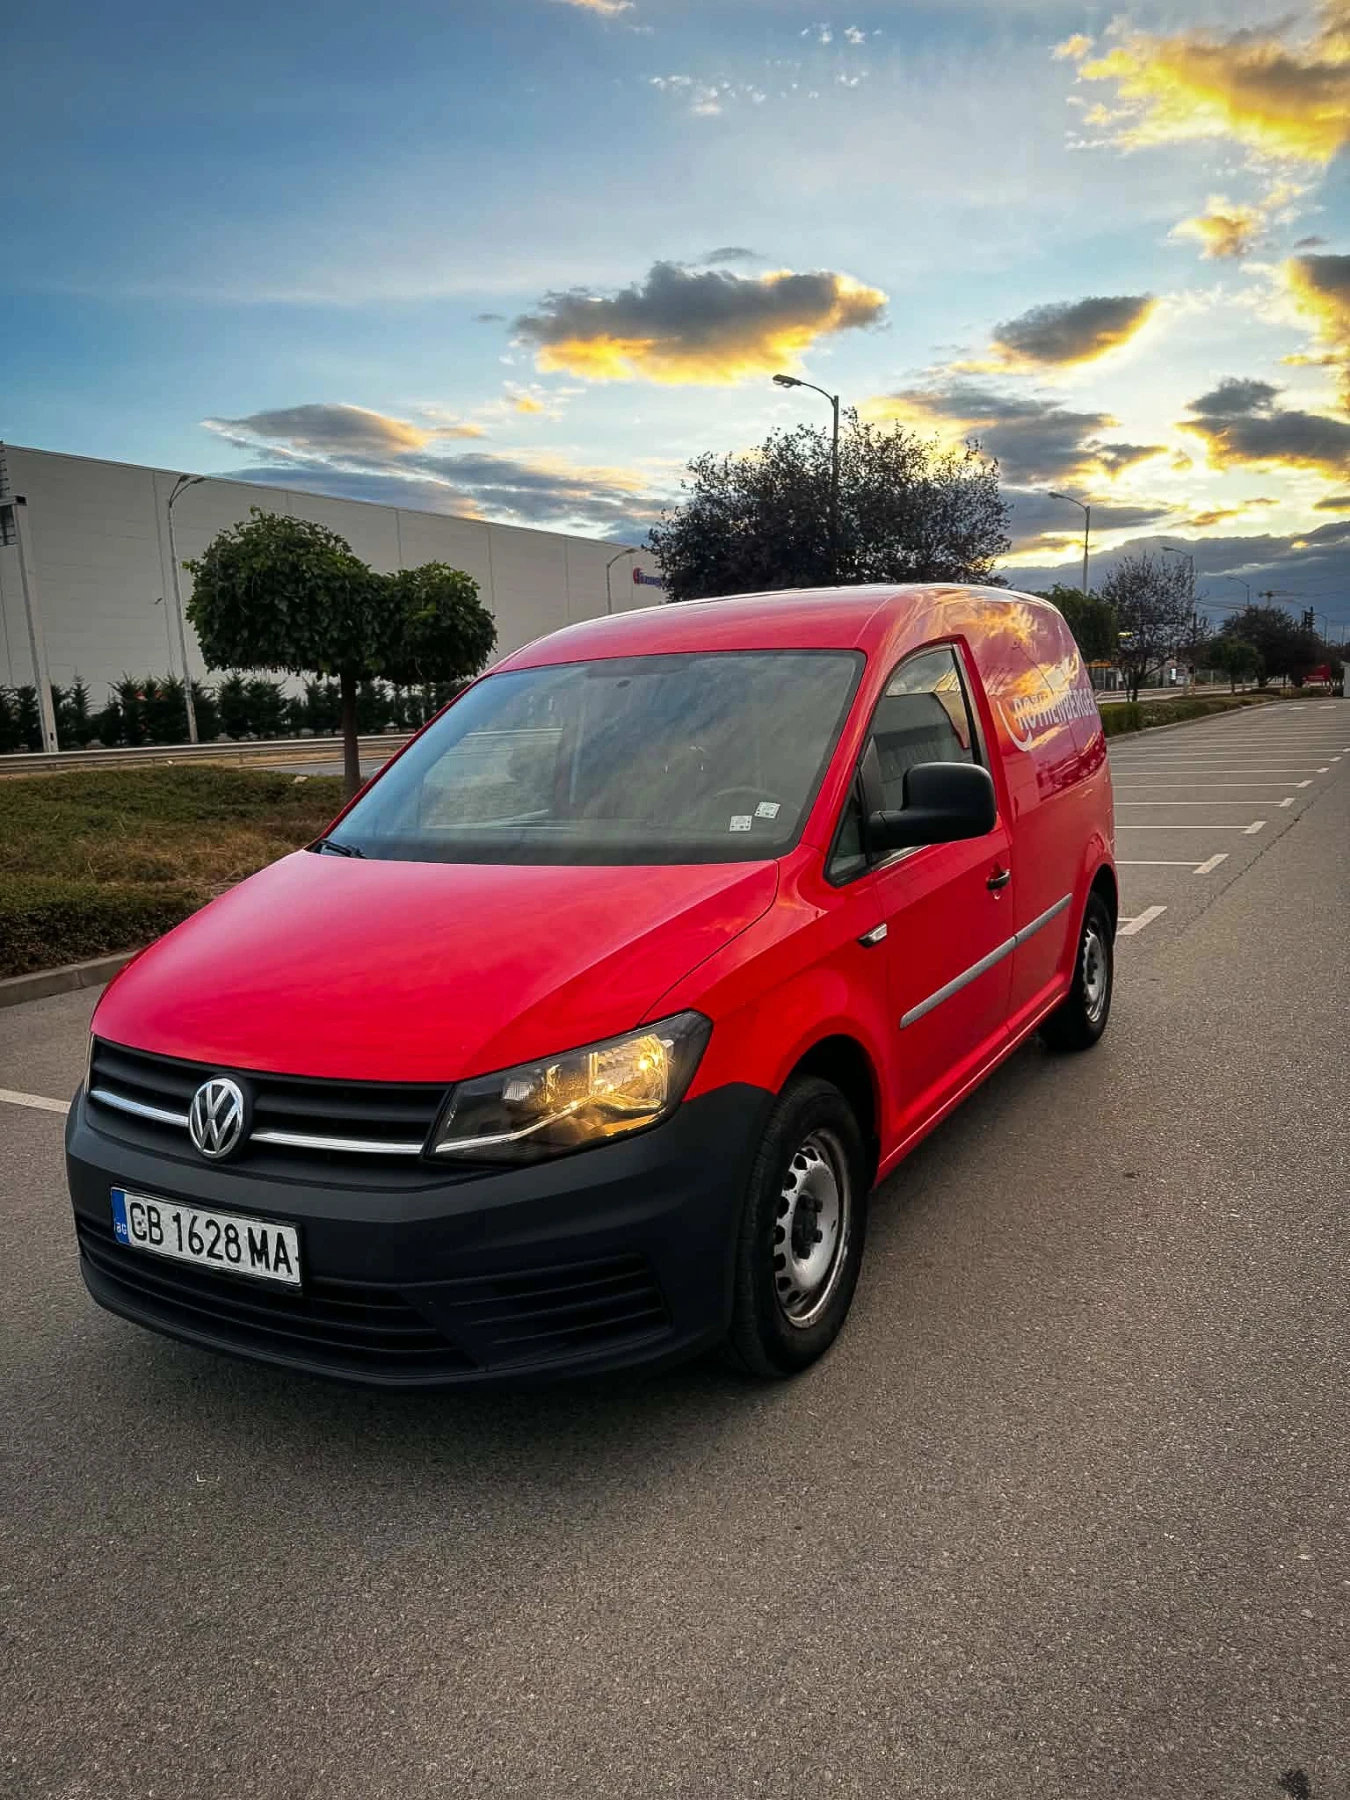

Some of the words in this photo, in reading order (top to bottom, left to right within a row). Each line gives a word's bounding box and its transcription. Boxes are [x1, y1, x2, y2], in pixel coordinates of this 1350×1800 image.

[116, 1221, 127, 1235] BG
[130, 1202, 163, 1246] CB
[172, 1212, 241, 1263] 1628
[247, 1226, 293, 1275] MA
